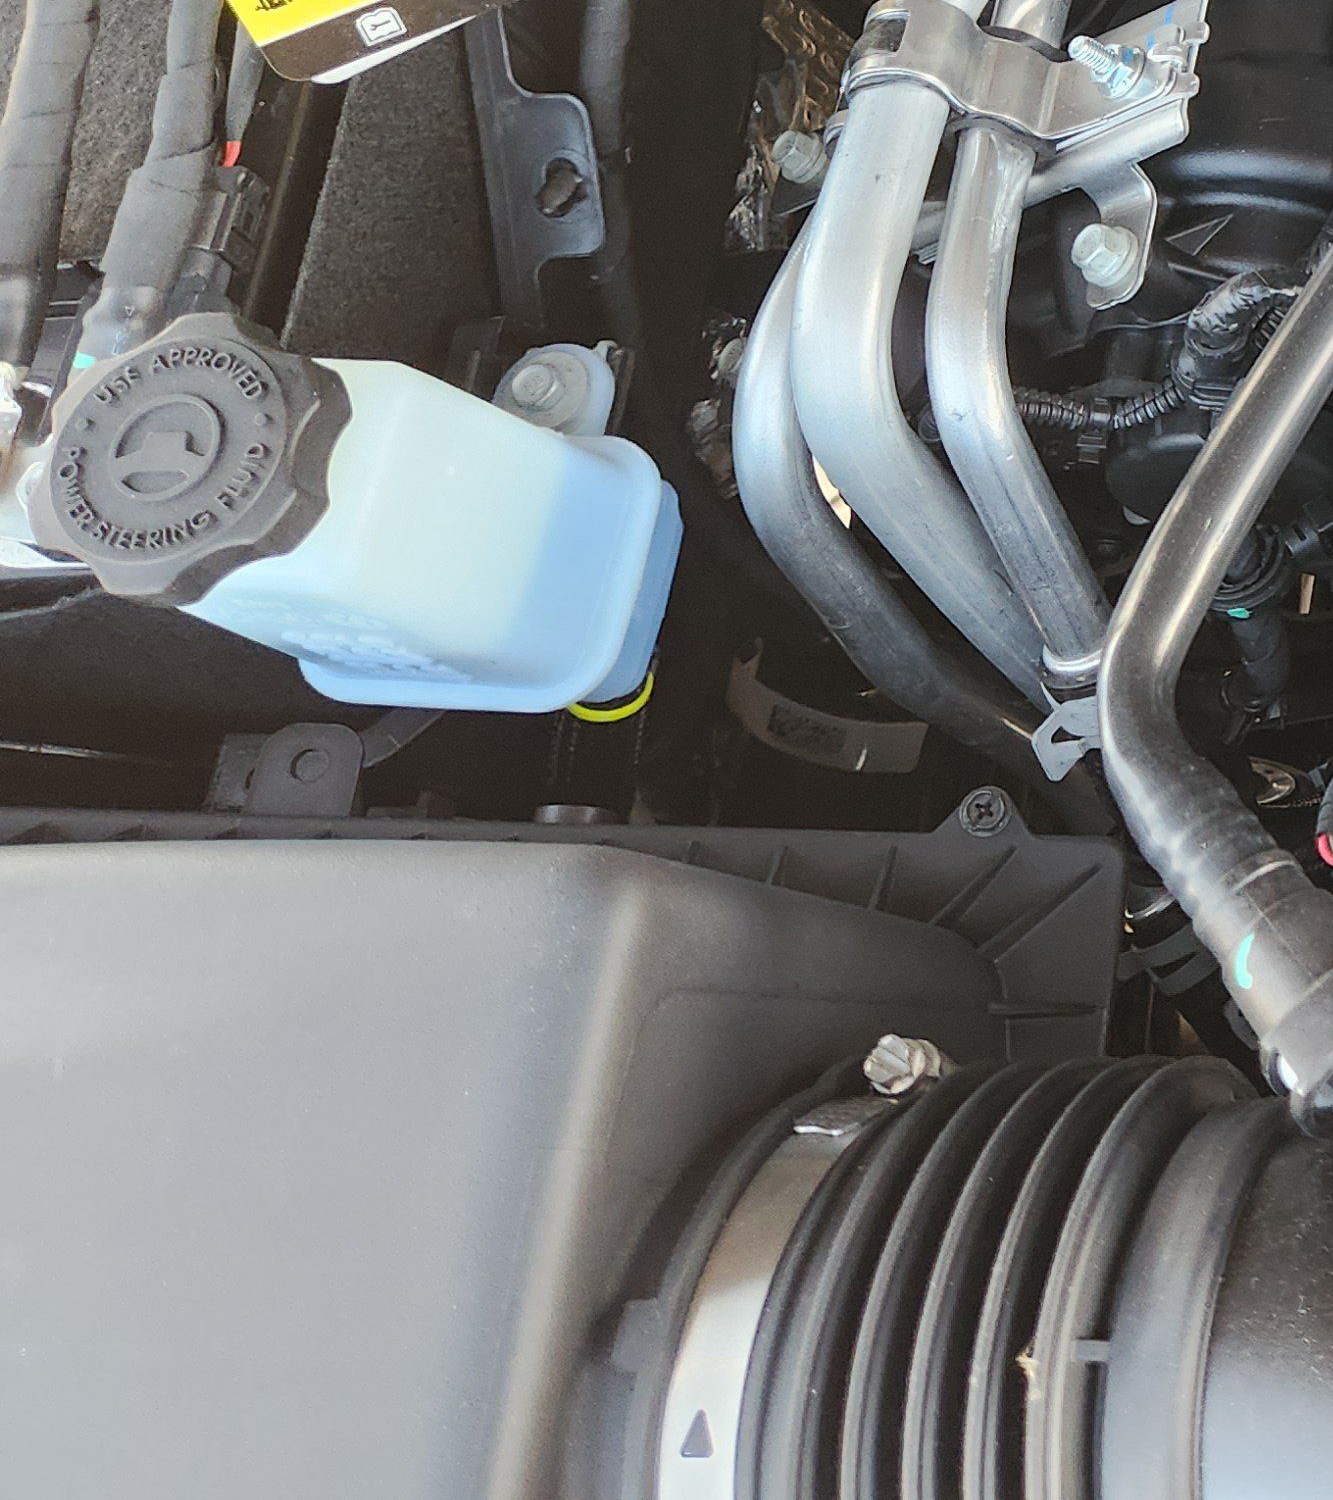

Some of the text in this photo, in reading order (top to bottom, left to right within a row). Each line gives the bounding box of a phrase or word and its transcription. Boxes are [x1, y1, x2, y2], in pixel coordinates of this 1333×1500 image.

[150, 347, 269, 400] APPROVED
[60, 443, 271, 550] POWER STEERING FLUID
